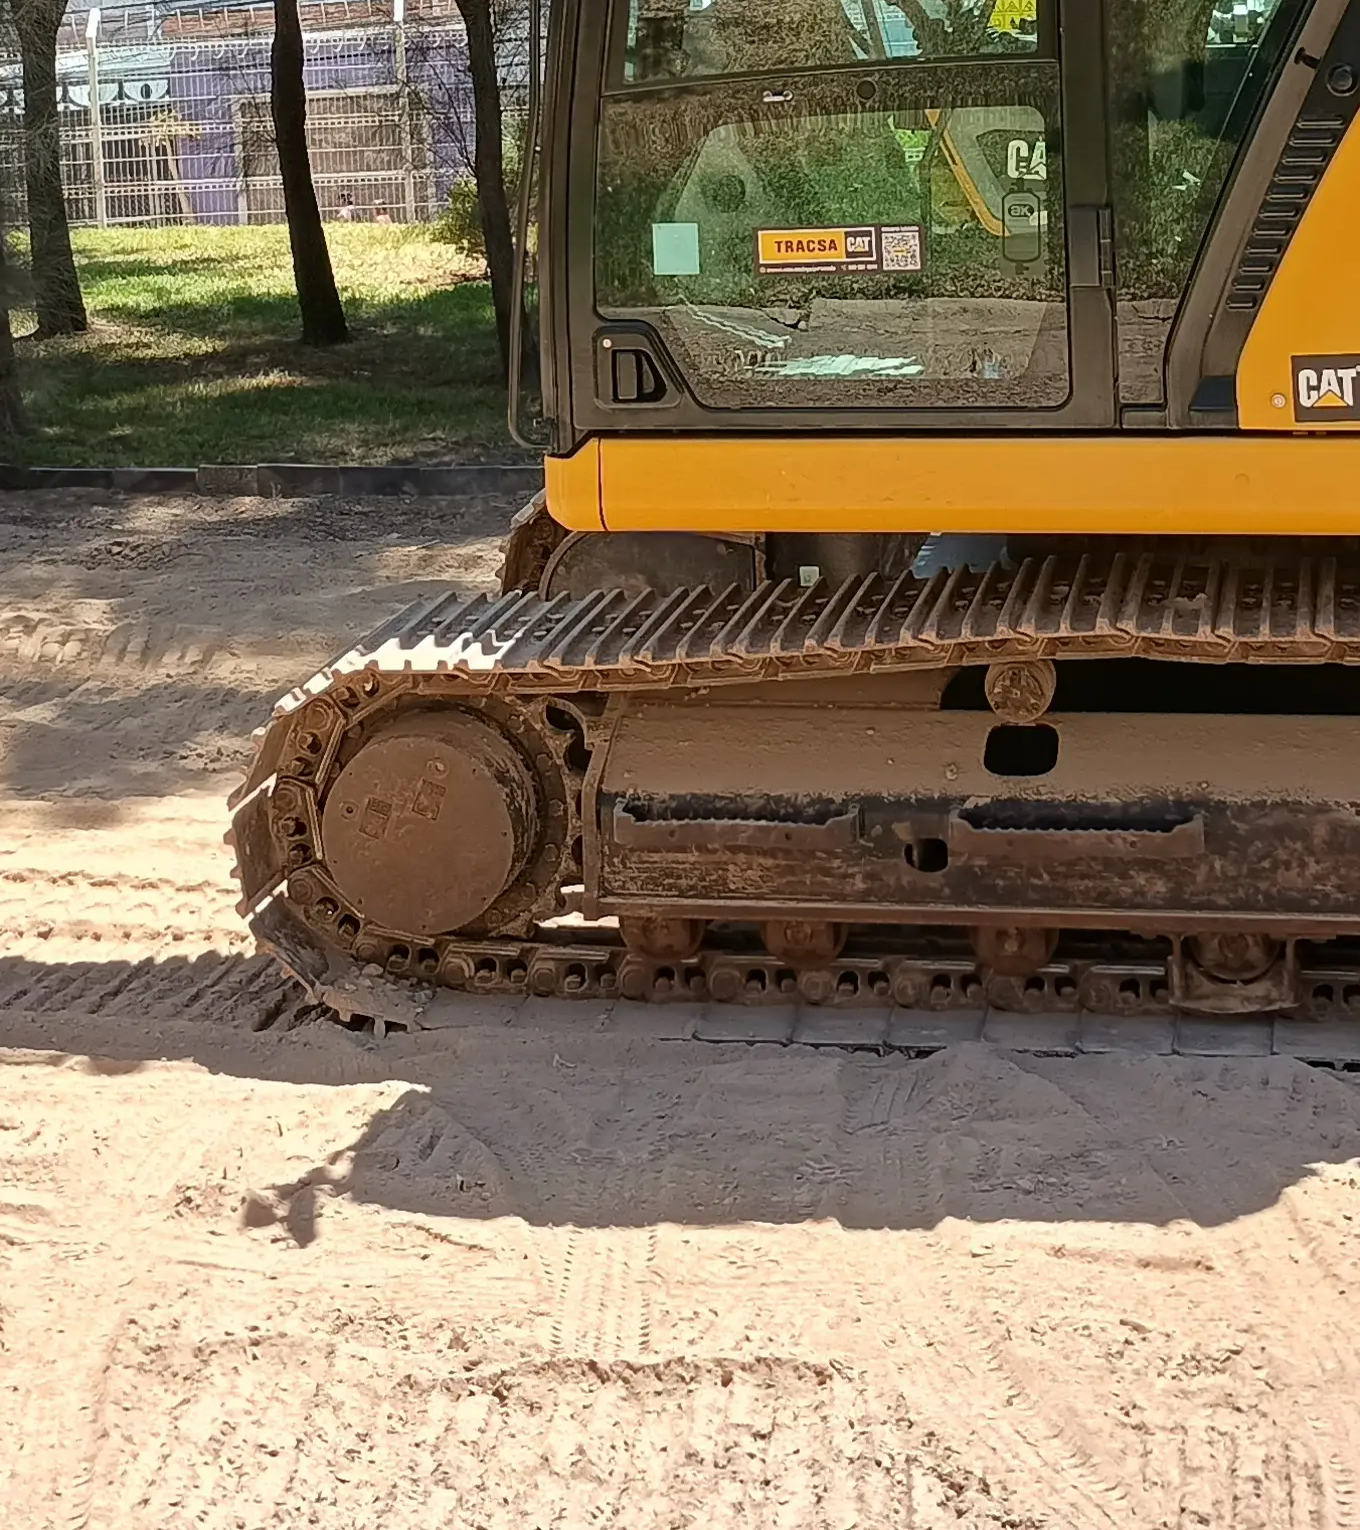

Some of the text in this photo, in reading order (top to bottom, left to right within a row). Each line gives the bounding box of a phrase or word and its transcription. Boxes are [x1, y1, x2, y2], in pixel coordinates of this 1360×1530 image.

[1007, 138, 1047, 180] CA
[773, 236, 871, 254] TRACSA CAT
[1298, 368, 1357, 408] CAT
